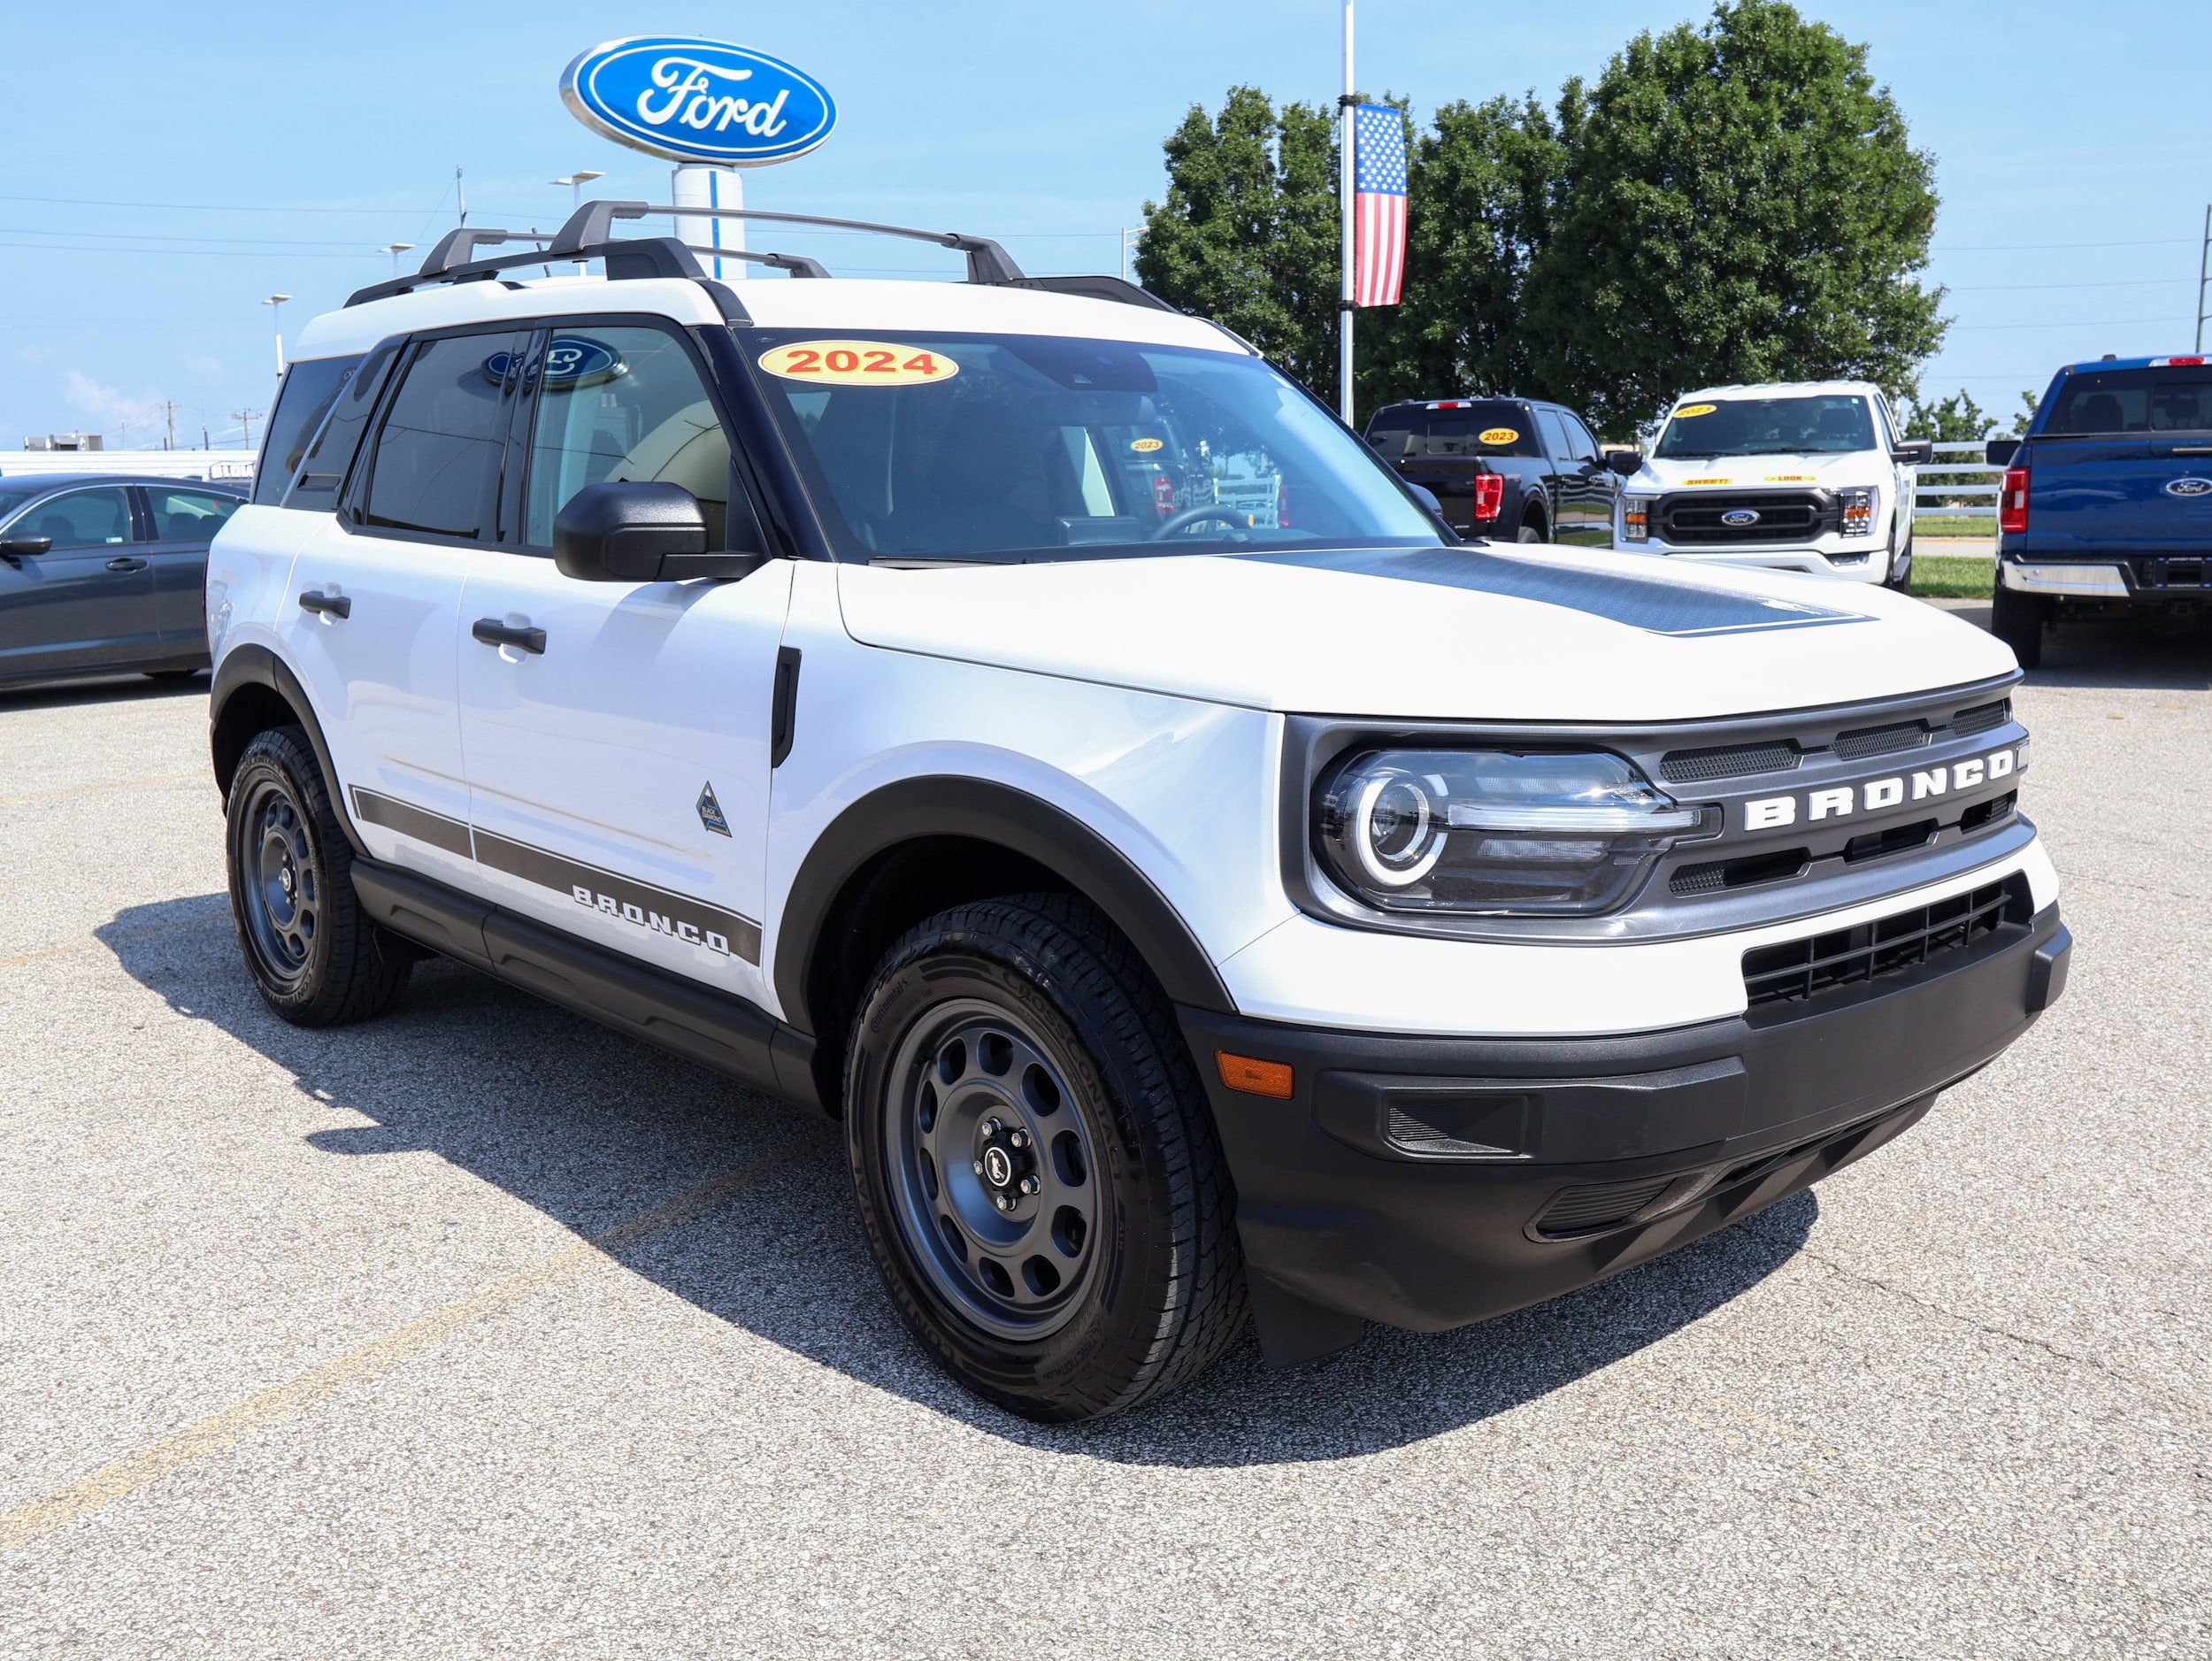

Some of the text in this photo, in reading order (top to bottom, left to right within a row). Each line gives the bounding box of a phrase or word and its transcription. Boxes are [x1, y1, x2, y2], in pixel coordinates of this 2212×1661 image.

[636, 57, 790, 137] Ford
[785, 350, 938, 375] 2024
[1134, 441, 1160, 450] 2023
[1484, 432, 1515, 441] 2023
[1744, 750, 2014, 831] BRONCO
[572, 885, 730, 957] BRONCO
[869, 979, 904, 1034] Continental
